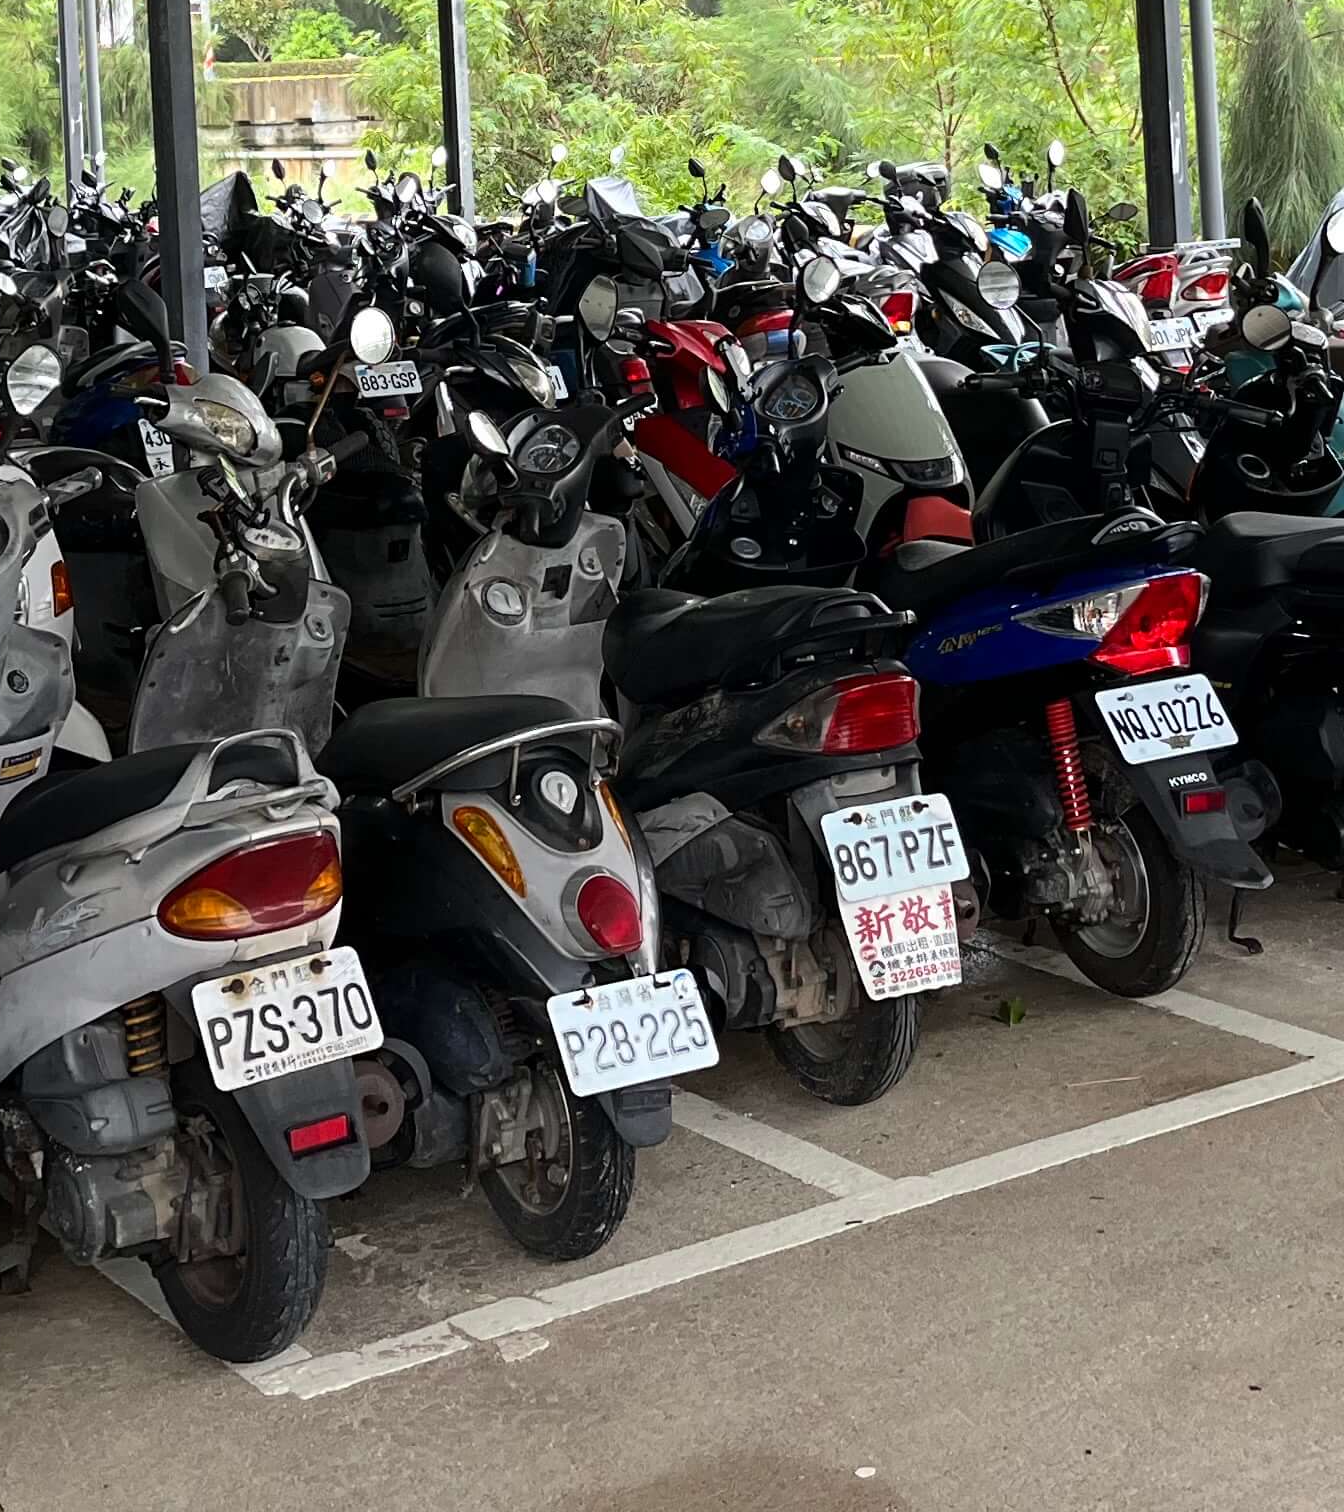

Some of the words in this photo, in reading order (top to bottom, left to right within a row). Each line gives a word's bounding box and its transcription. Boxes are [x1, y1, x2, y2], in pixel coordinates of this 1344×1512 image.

[360, 371, 417, 392] 883-GSP
[1108, 692, 1225, 745] NQJ-0226
[1169, 772, 1208, 788] KYMCO
[834, 822, 956, 885] 867-PZF
[207, 982, 373, 1070] PZS-370
[562, 1002, 709, 1077] P28-225
